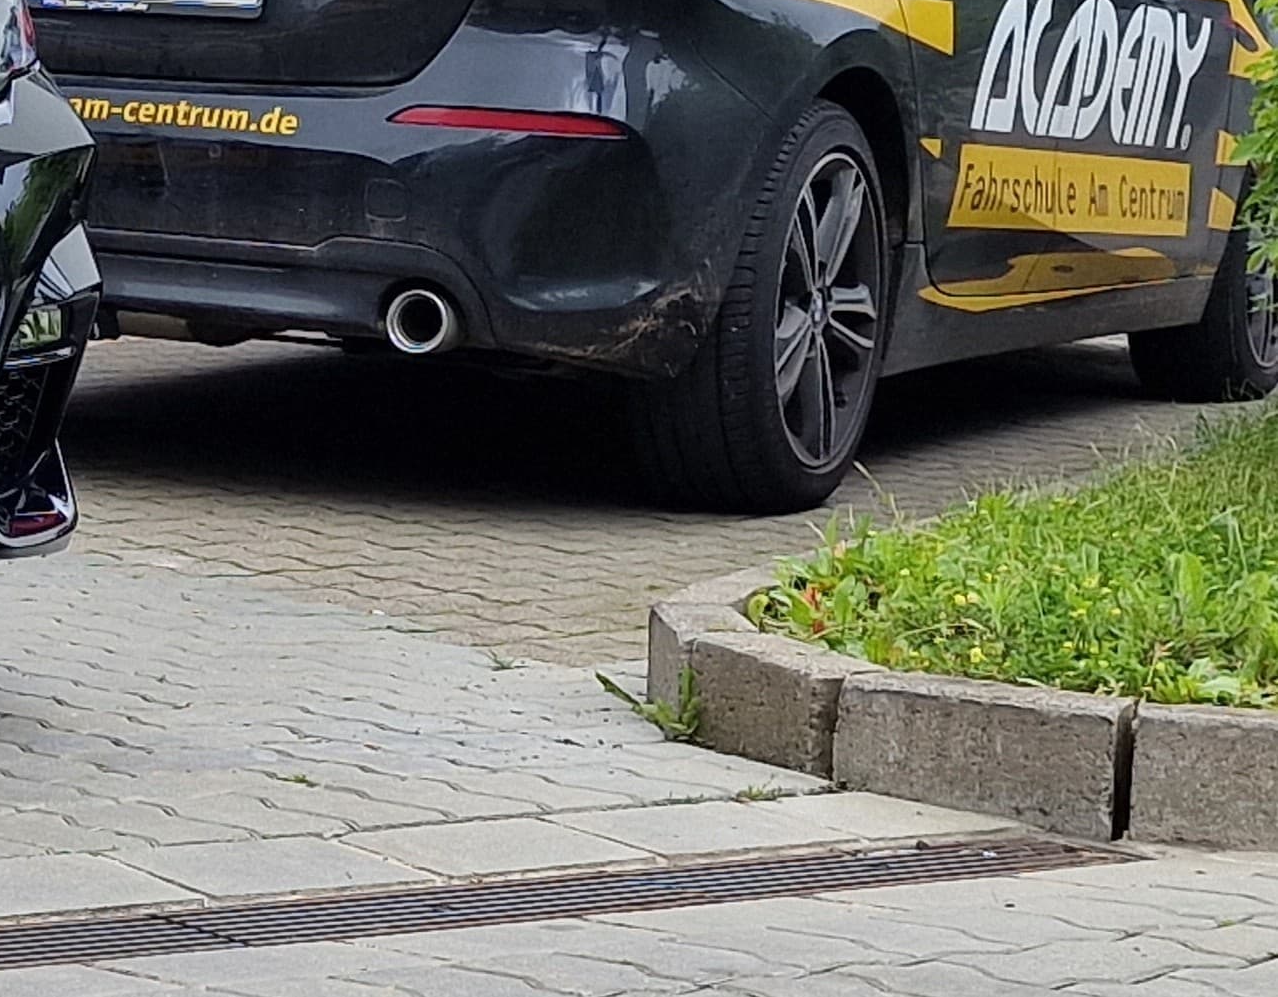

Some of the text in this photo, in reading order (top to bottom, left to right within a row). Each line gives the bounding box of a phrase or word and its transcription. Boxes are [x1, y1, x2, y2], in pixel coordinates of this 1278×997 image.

[958, 161, 1186, 220] Fahrschule Am Centrum
